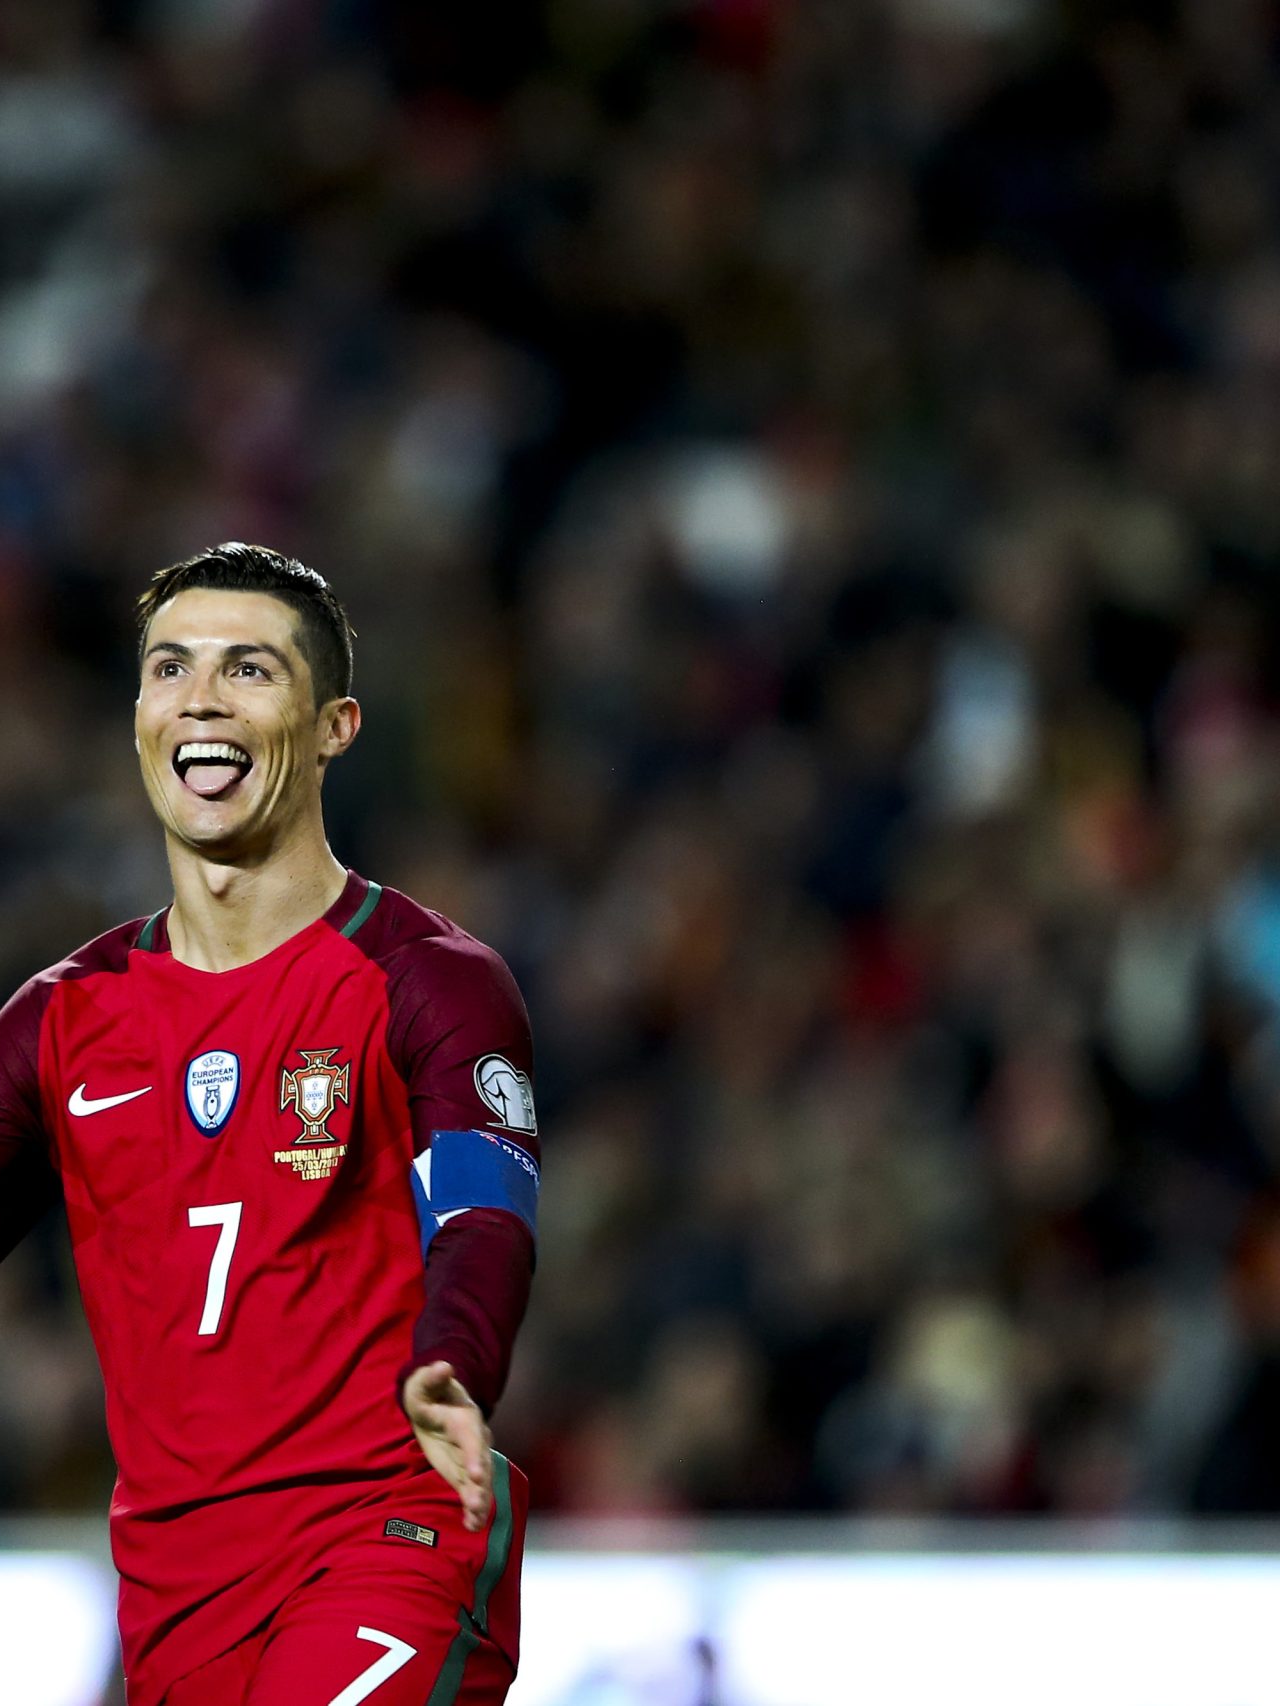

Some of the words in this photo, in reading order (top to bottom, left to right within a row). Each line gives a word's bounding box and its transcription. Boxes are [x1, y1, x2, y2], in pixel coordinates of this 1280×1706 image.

[202, 1055, 225, 1068] UEFA
[192, 1067, 234, 1079] EUROPEAN
[192, 1075, 234, 1086] CHAMPIONS
[292, 1157, 339, 1172] 25/03/2017
[301, 1168, 331, 1181] LISBOA
[188, 1201, 243, 1336] 7
[327, 1626, 418, 1706] 7
